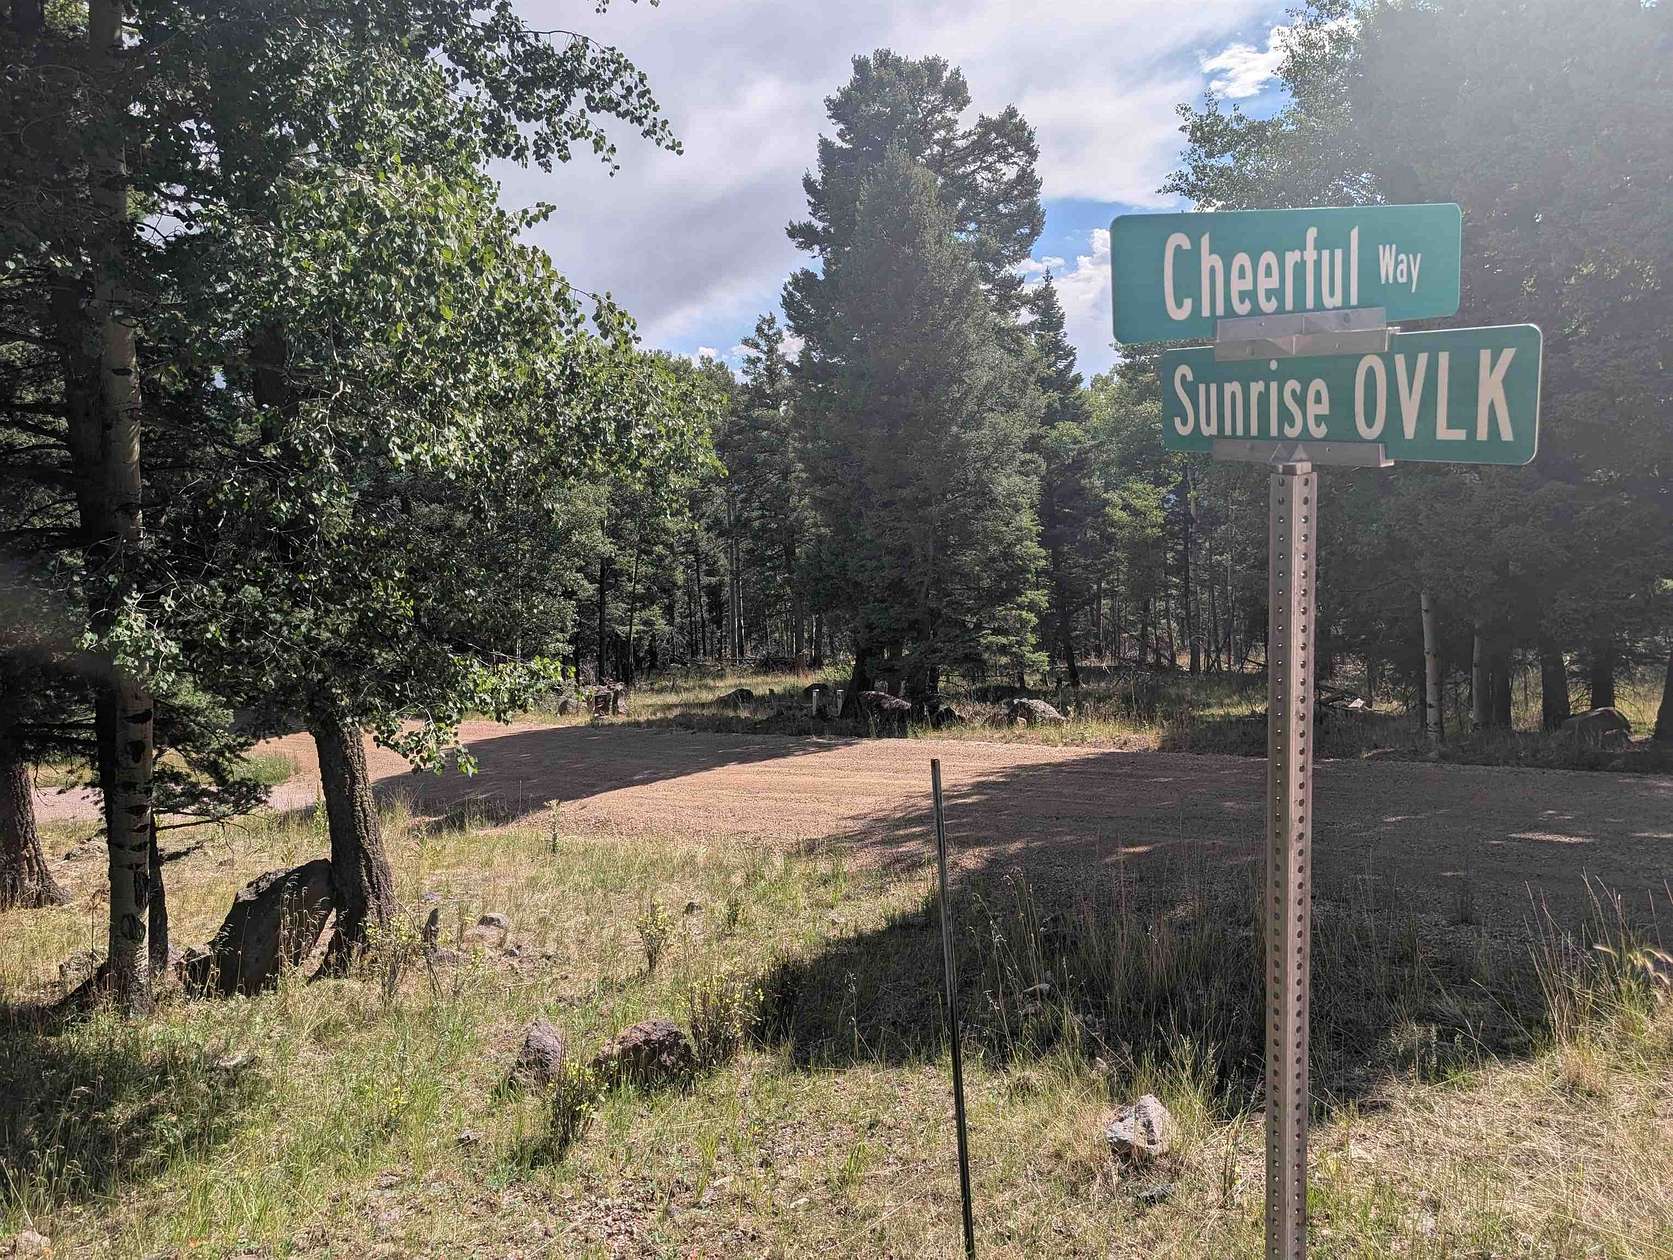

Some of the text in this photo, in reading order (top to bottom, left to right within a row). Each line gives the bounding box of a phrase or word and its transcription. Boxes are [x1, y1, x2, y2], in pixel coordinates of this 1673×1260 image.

[1163, 225, 1422, 321] Cheerful Way
[1173, 347, 1518, 442] Sunrise OVLK
